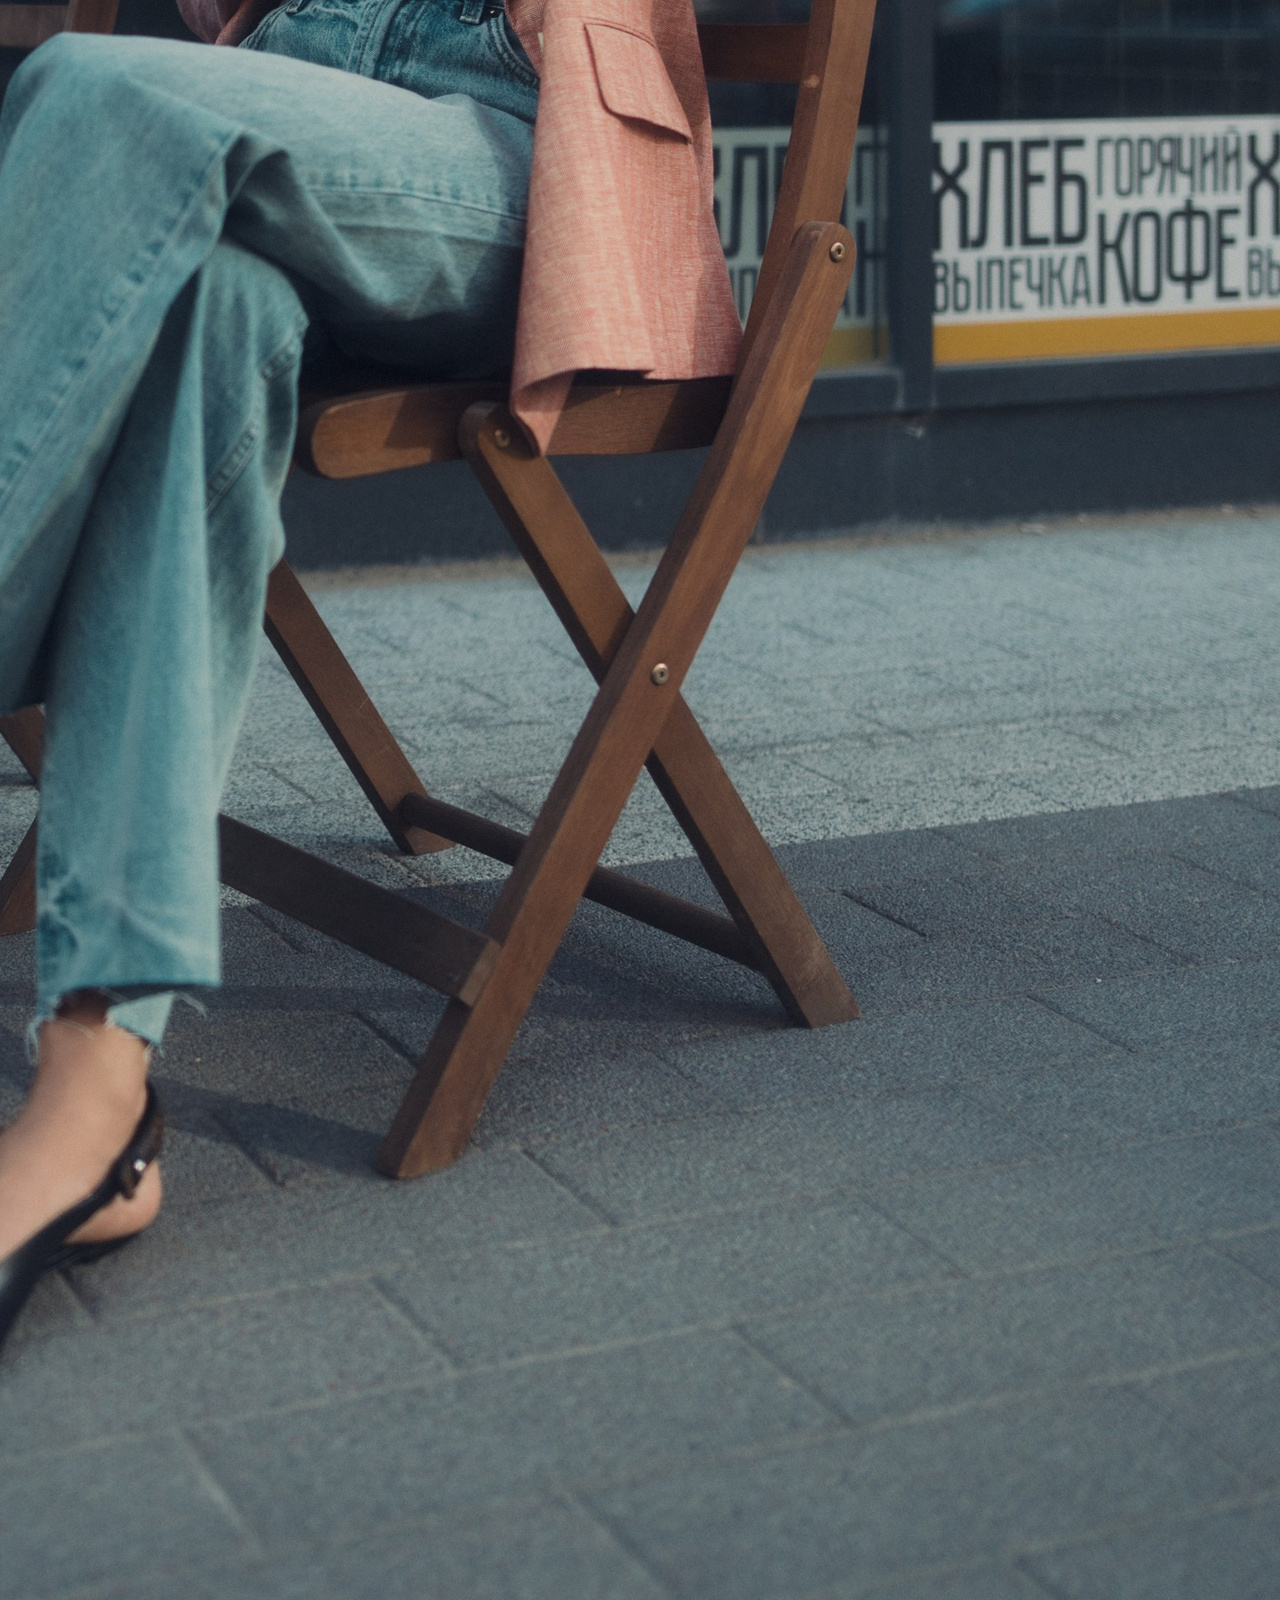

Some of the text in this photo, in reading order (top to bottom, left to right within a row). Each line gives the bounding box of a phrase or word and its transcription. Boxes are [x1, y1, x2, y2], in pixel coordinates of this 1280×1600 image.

[933, 137, 1088, 250] ХЛЕБ
[1096, 129, 1242, 196] ГОРЯЧИЙ
[934, 255, 1091, 313] ВЫПЕЧКА
[1098, 200, 1240, 304] КОФЕ
